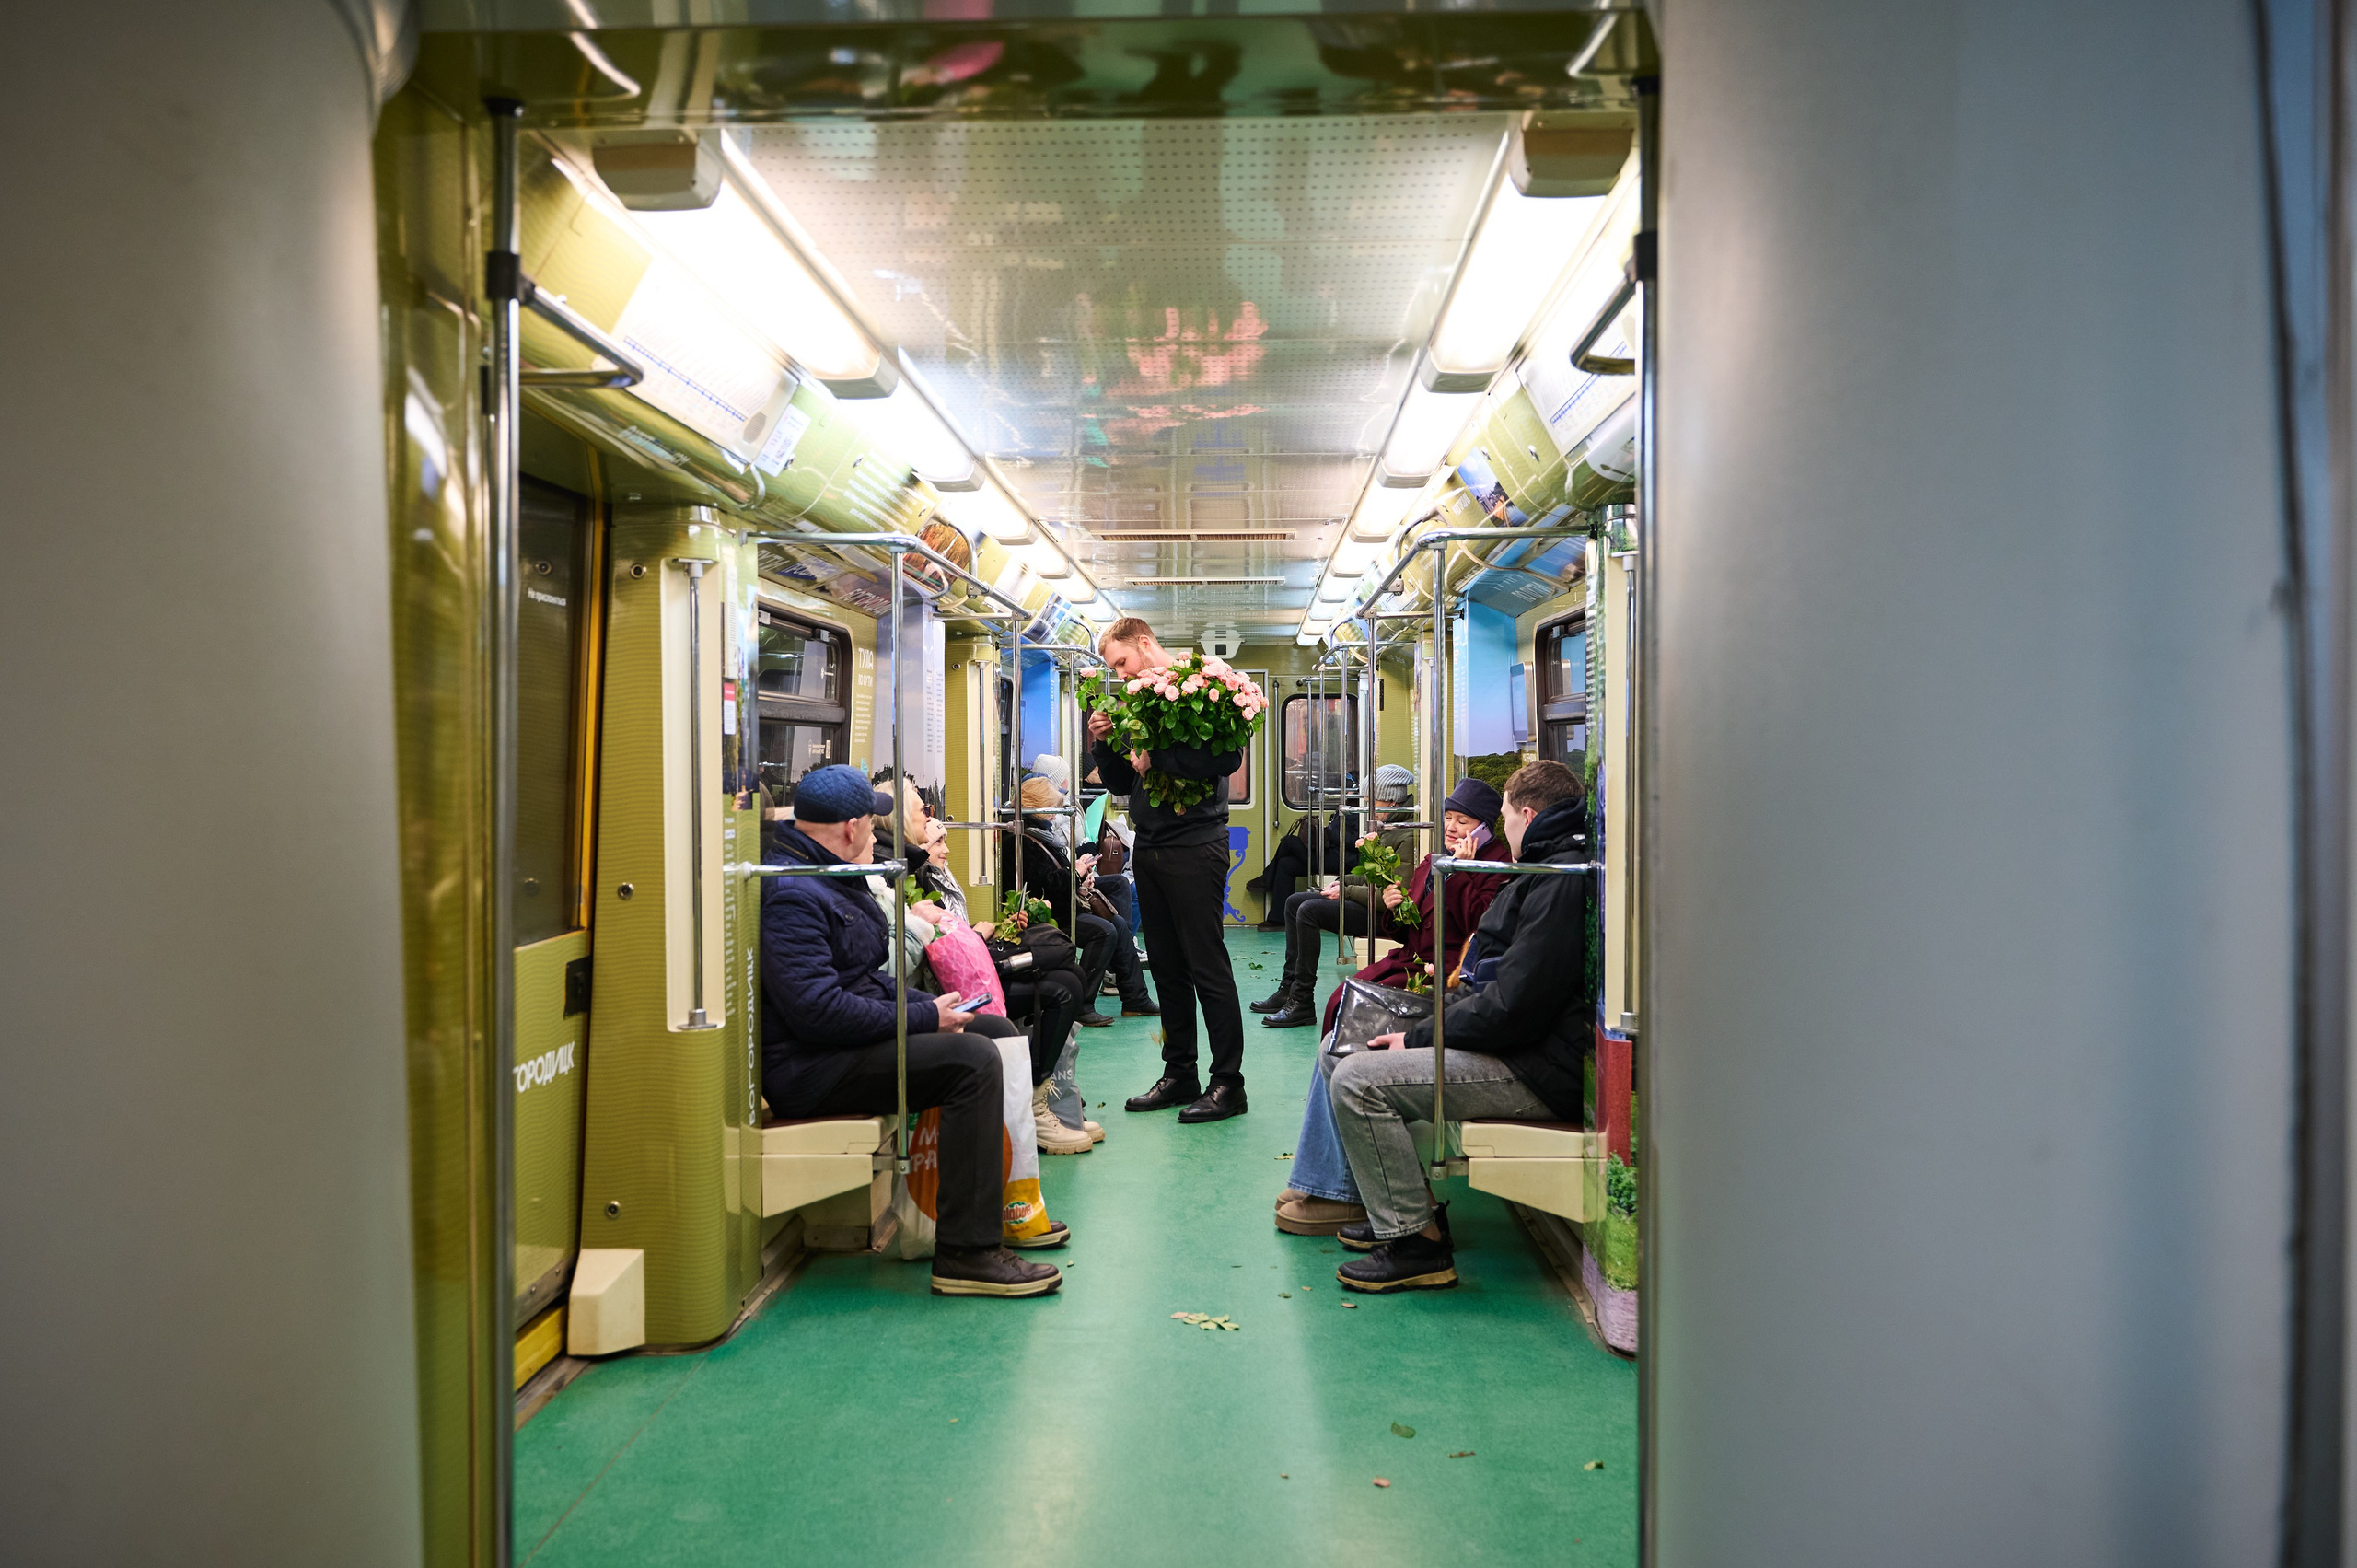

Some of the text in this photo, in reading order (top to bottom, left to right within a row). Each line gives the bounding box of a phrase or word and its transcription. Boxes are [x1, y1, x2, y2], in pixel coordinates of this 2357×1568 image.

[857, 647, 874, 670] ТУЛА
[746, 947, 756, 1126] БОГОРОДИЦК
[1050, 1068, 1073, 1081] ANS
